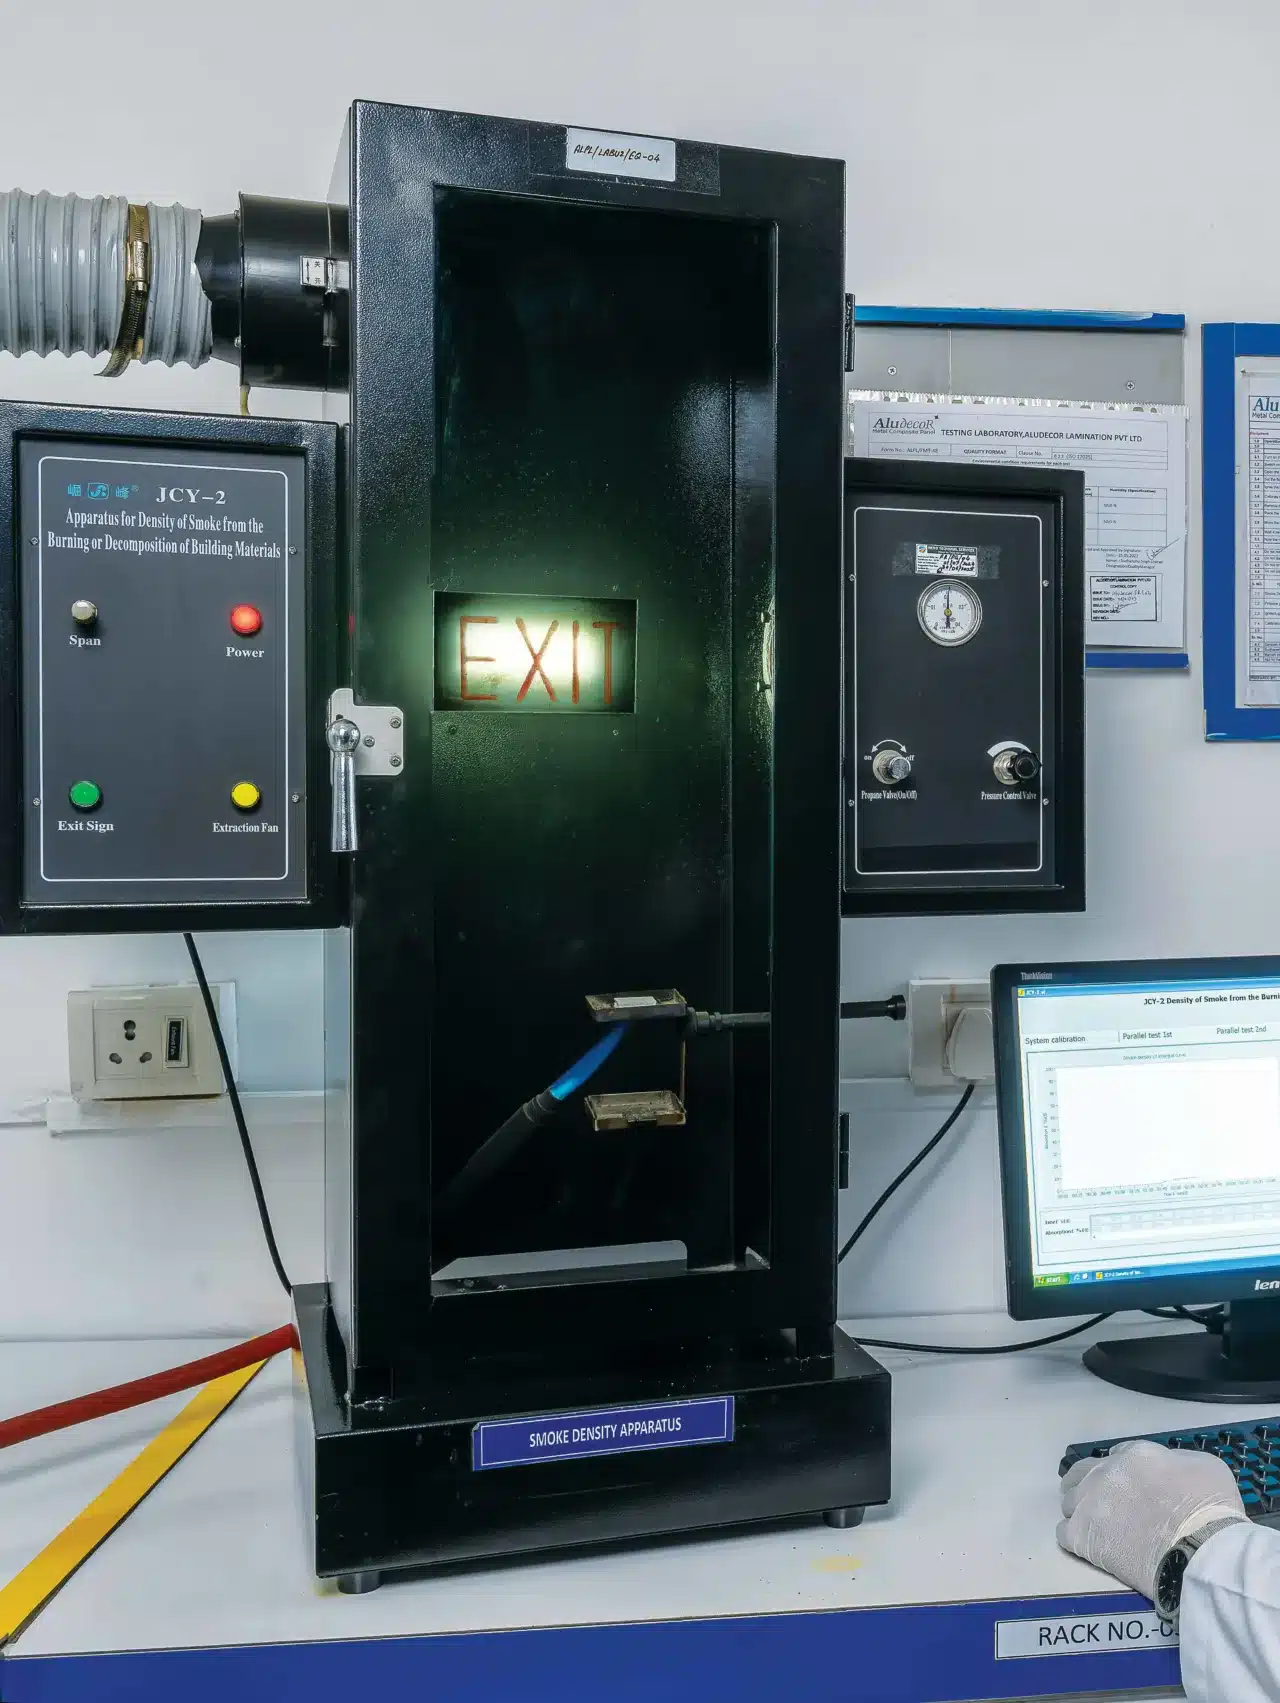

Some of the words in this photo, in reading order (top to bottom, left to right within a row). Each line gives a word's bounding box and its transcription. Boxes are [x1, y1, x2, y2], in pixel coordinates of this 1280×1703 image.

[940, 429, 973, 437] TESTING
[1065, 433, 1113, 441] LAMINATION
[1114, 434, 1129, 442] PVT
[65, 507, 120, 528] Apparatus
[121, 511, 136, 527] for
[138, 511, 176, 533] Density
[177, 514, 188, 530] of
[188, 514, 221, 531] Smoke
[223, 516, 247, 533] from
[248, 517, 264, 533] the
[47, 531, 90, 553] Burning
[91, 537, 103, 550] or
[104, 534, 178, 555] Decomposition
[179, 538, 191, 554] of
[191, 538, 233, 560] Building
[234, 540, 281, 558] Materials
[68, 633, 102, 649] Span
[225, 646, 265, 659] Power
[459, 615, 624, 705] EXIT
[906, 754, 915, 762] off
[861, 791, 883, 801] Propane
[881, 790, 918, 800] Valve(On/Off)
[980, 791, 1002, 800] Pressure
[1002, 791, 1022, 800] Control
[1022, 792, 1037, 800] Valve
[56, 819, 84, 832] Exit
[85, 819, 115, 835] Sign
[211, 822, 260, 834] Extraction
[260, 822, 279, 834] Fan
[1143, 997, 1165, 1005] JCY-2
[1166, 995, 1194, 1005] Density
[1194, 995, 1203, 1003] of
[1203, 995, 1228, 1003] Smoke
[1229, 994, 1247, 1002] from
[1248, 993, 1260, 1001] the
[1122, 1032, 1147, 1040] Parallel
[1162, 1031, 1173, 1039] 1st
[1216, 1027, 1240, 1035] Parallel
[1025, 1037, 1050, 1046] System
[1051, 1035, 1086, 1043] calibration
[529, 1431, 569, 1449] SMOKE
[572, 1424, 618, 1443] DENSITY
[619, 1416, 682, 1437] APPARATUS
[1038, 1623, 1101, 1647] RACK
